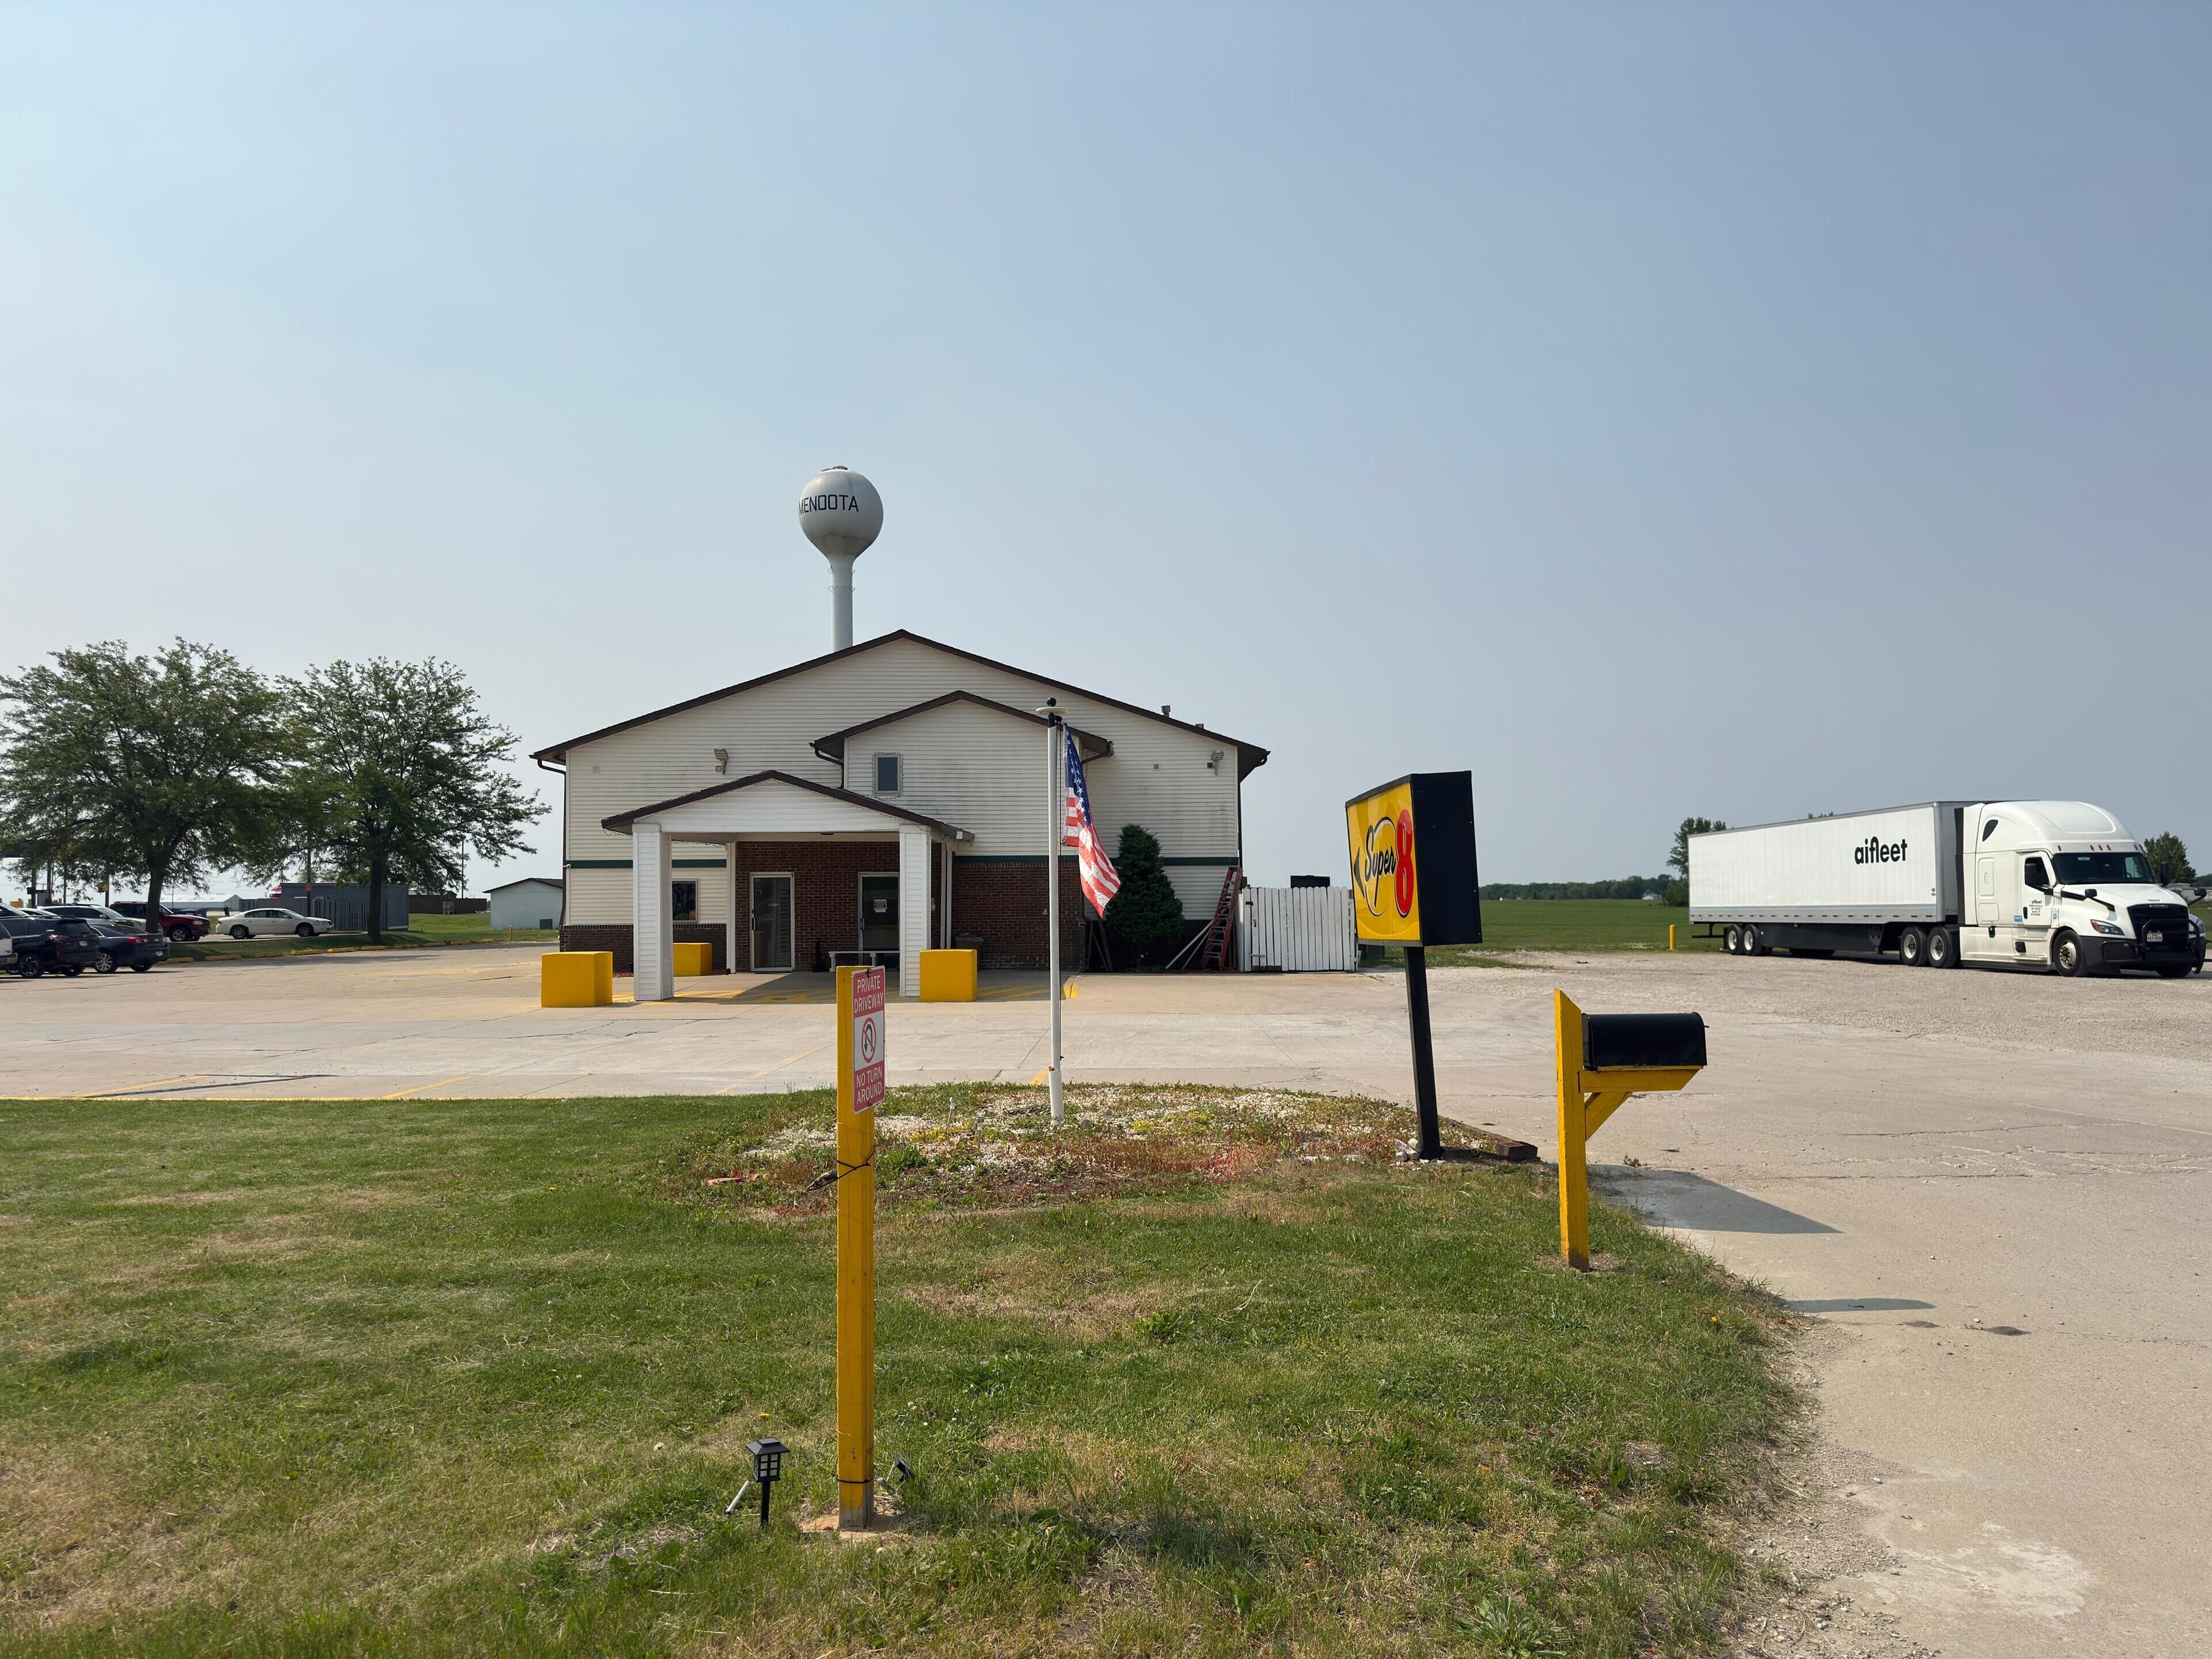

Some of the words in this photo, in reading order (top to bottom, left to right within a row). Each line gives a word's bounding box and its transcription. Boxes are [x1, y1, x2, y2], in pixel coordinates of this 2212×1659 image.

[799, 494, 859, 515] MENDOTA
[1854, 836, 1908, 865] aifleet
[1364, 824, 1396, 908] Super
[1395, 809, 1414, 918] 8
[857, 975, 880, 994] PRIVATE
[854, 991, 884, 1013] DRIVEWAY
[857, 1073, 866, 1088] NO
[866, 1066, 882, 1084] TURN
[857, 1081, 882, 1105] AROUND
